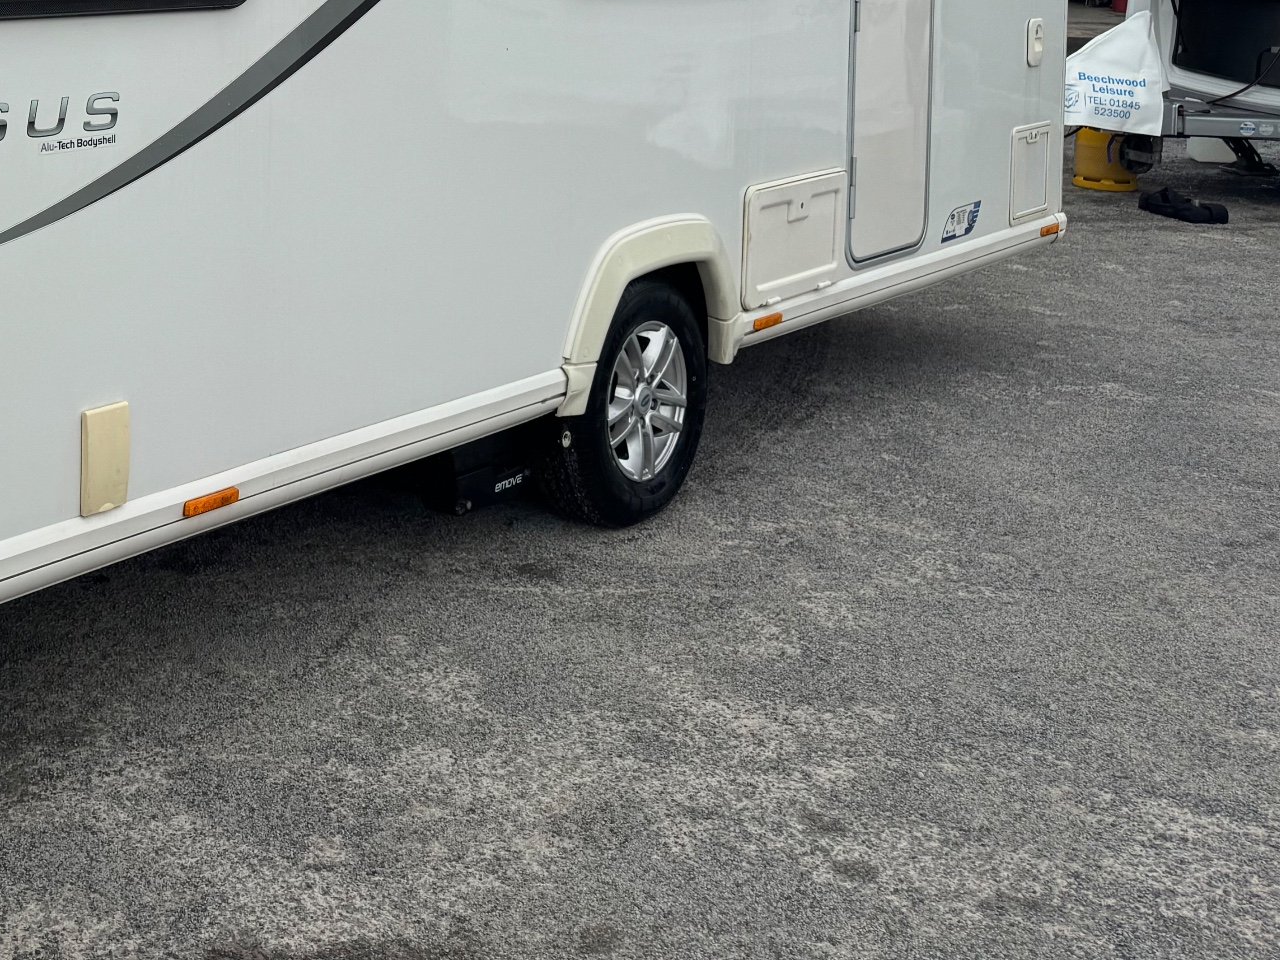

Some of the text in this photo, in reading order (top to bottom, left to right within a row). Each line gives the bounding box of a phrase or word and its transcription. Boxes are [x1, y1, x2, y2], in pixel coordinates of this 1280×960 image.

[1078, 71, 1147, 88] Beechwood
[1092, 83, 1135, 98] Leisure
[1088, 95, 1142, 111] TEL: 01845
[1094, 106, 1131, 120] 523500
[40, 133, 116, 153] Alu-Tech Bodyshell
